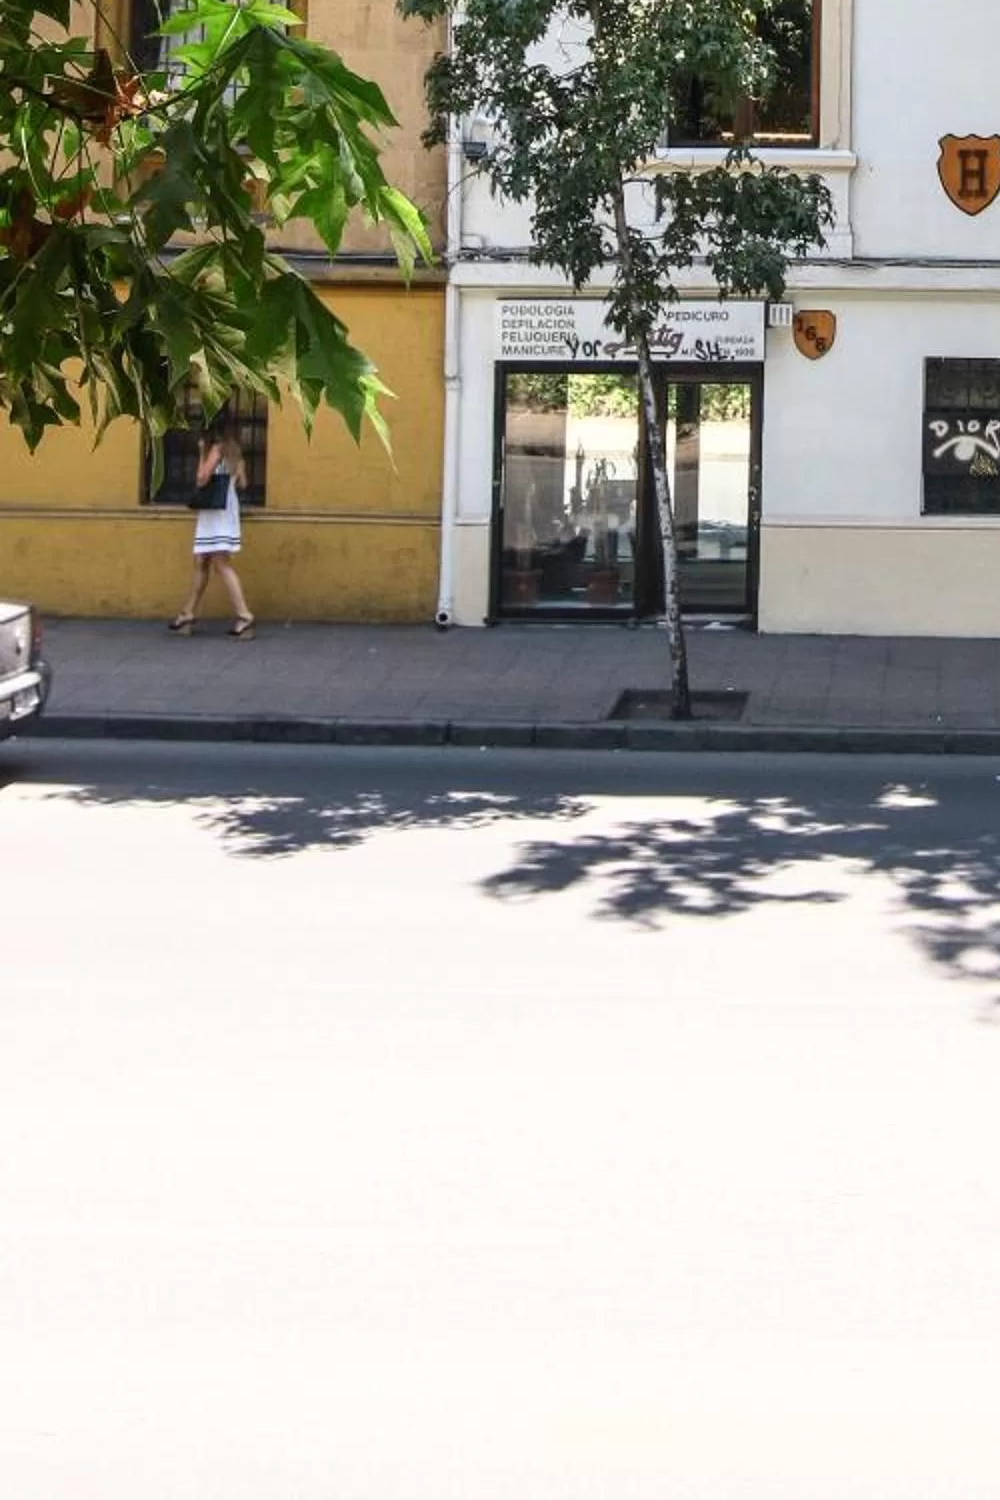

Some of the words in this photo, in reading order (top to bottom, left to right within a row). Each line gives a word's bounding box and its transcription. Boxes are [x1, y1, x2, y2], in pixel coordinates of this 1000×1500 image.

[958, 150, 987, 198] H
[501, 305, 575, 316] PODOLOGIA
[667, 311, 729, 322] PEDICURO
